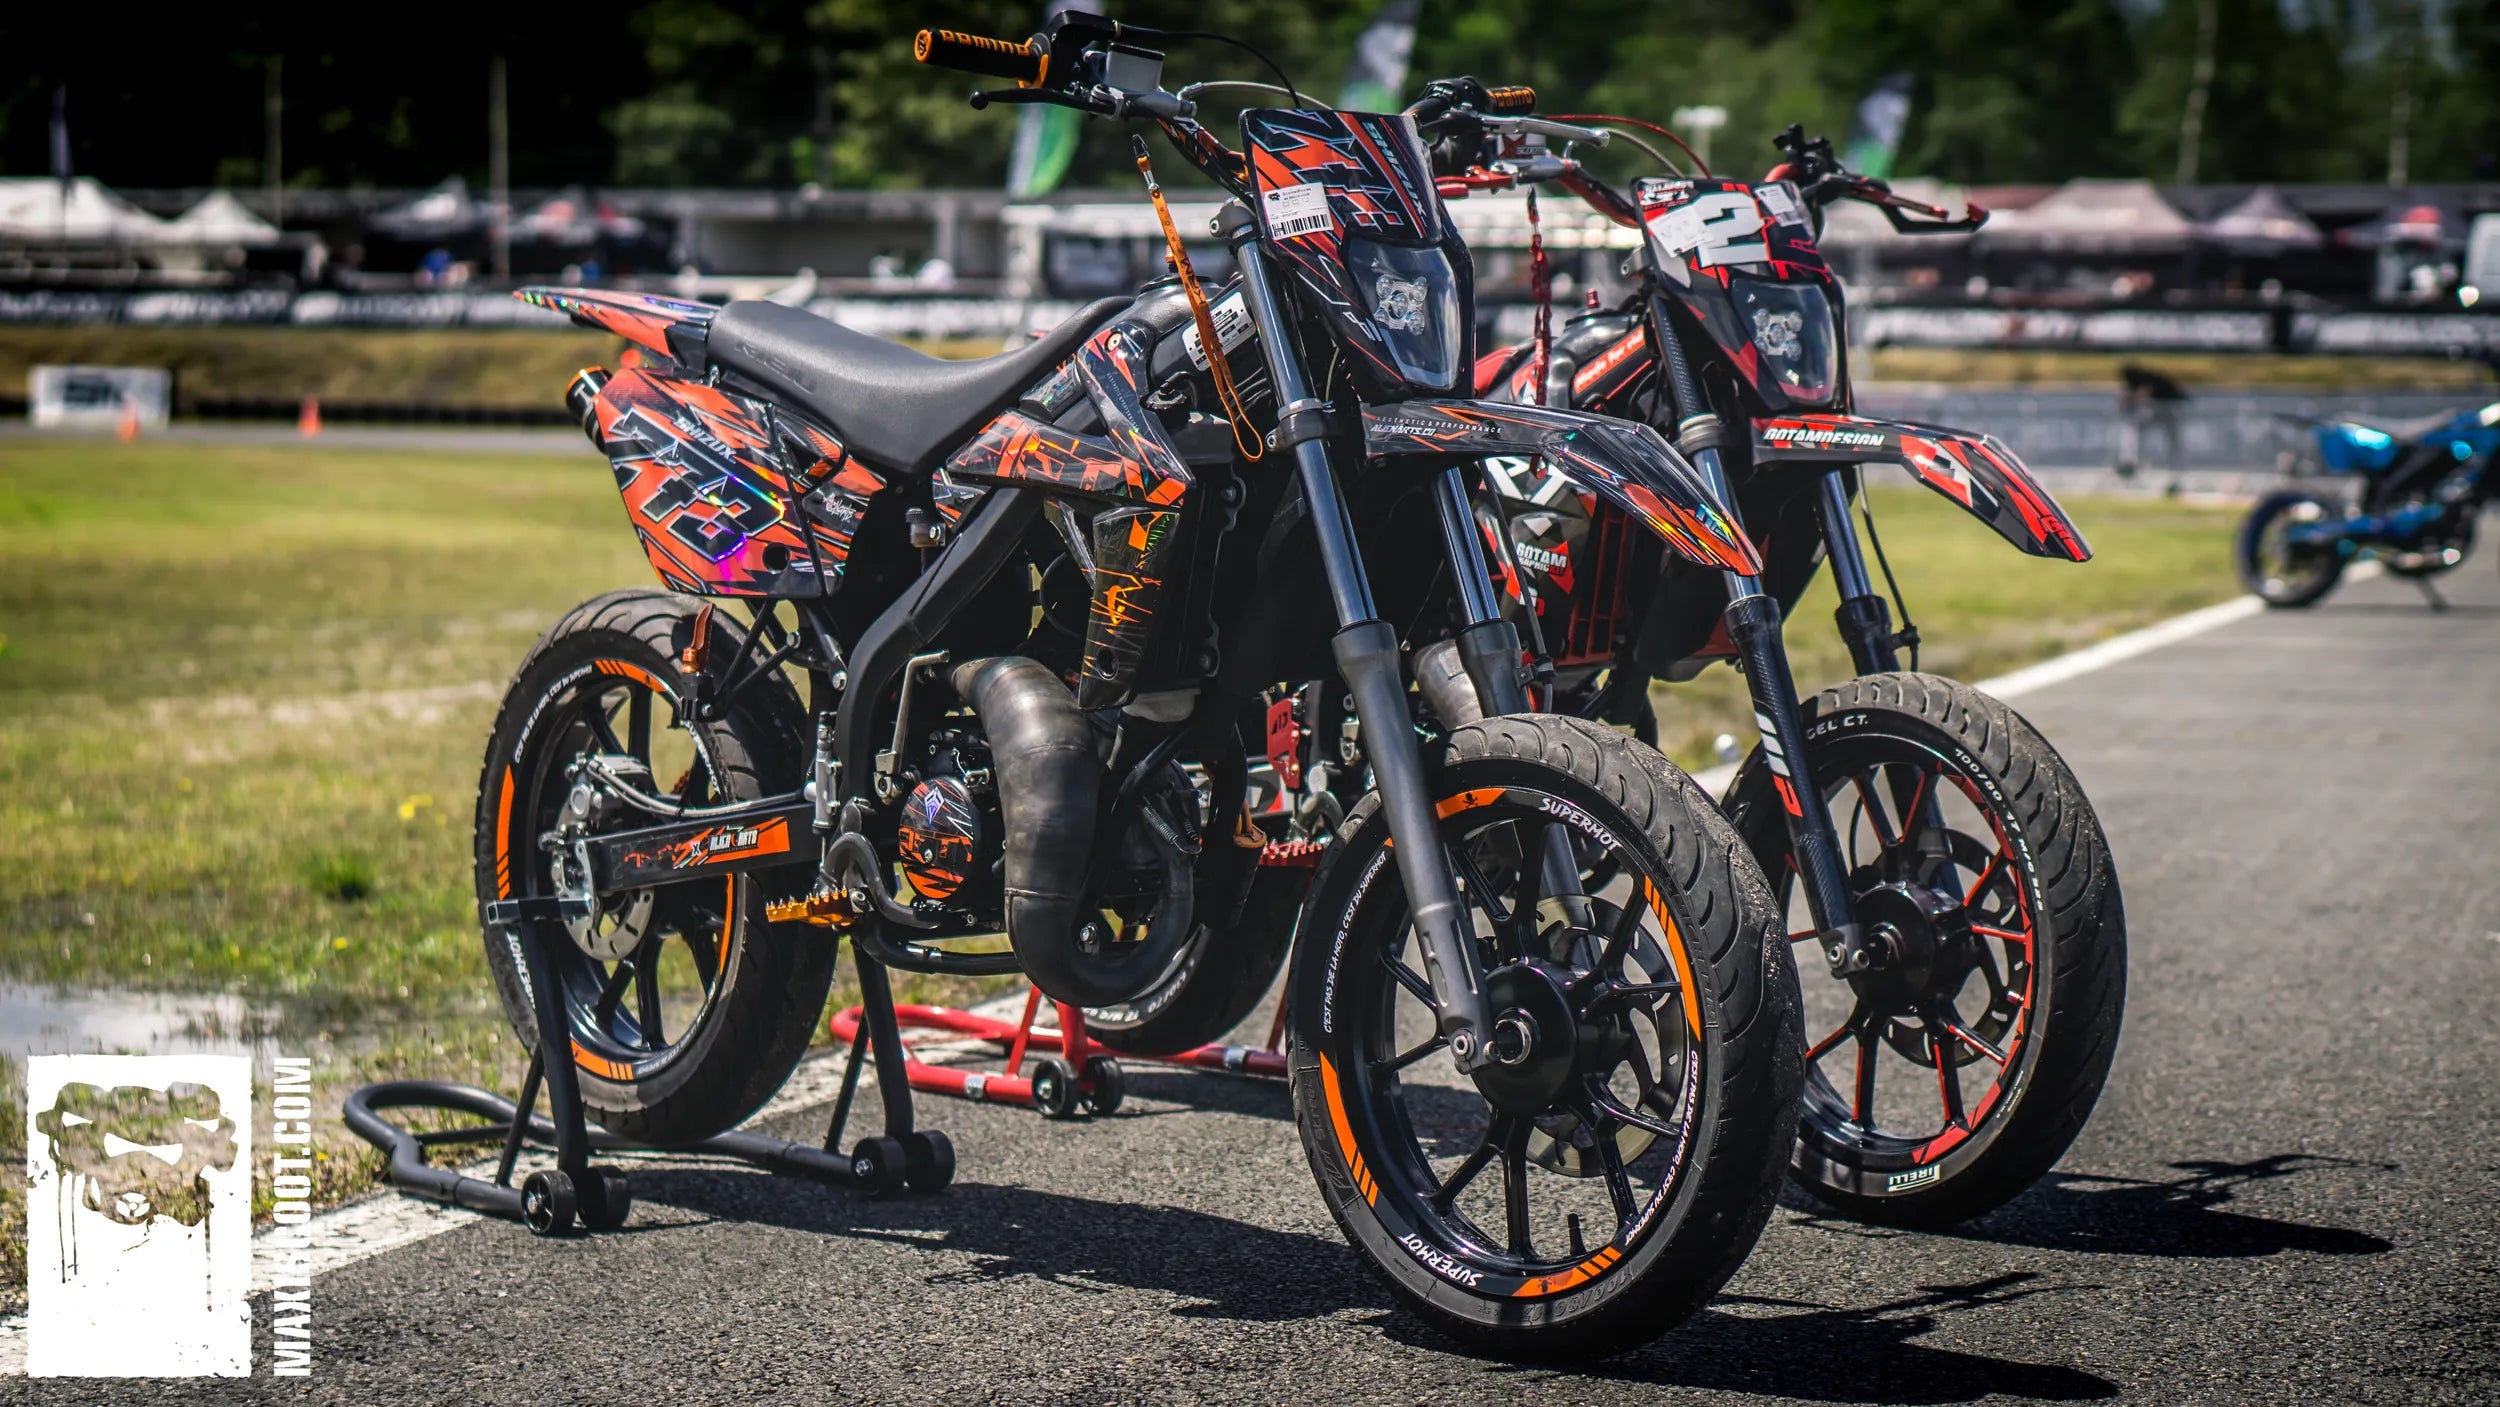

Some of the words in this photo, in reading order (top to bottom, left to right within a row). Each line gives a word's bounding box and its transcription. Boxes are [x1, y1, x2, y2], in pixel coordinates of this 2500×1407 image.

[1362, 121, 1427, 216] SHIZUX
[1693, 191, 1768, 268] 2
[673, 416, 737, 460] SHIZUX
[1375, 416, 1425, 426] AESTHETIC
[1435, 421, 1502, 434] PERFORMANCE
[1763, 427, 1886, 447] GOTAMDESIGN
[1516, 542, 1568, 568] GOTAM
[1807, 721, 1838, 740] GEL
[1955, 749, 2003, 802] 100/80
[2006, 811, 2021, 831] 17
[1538, 799, 1623, 850] SUPERMOT
[1360, 851, 1387, 893] SUPERMOT
[1354, 890, 1364, 903] DU
[1342, 904, 1355, 929] C'EST
[1334, 931, 1348, 956] MOTO,
[1331, 956, 1338, 970] LA
[1327, 969, 1335, 985] DE
[1325, 987, 1333, 1004] PAS
[1323, 1007, 1332, 1033] C'EST
[1888, 1164, 1940, 1192] PIRELLI
[1398, 1234, 1484, 1286] SUPERMOT
